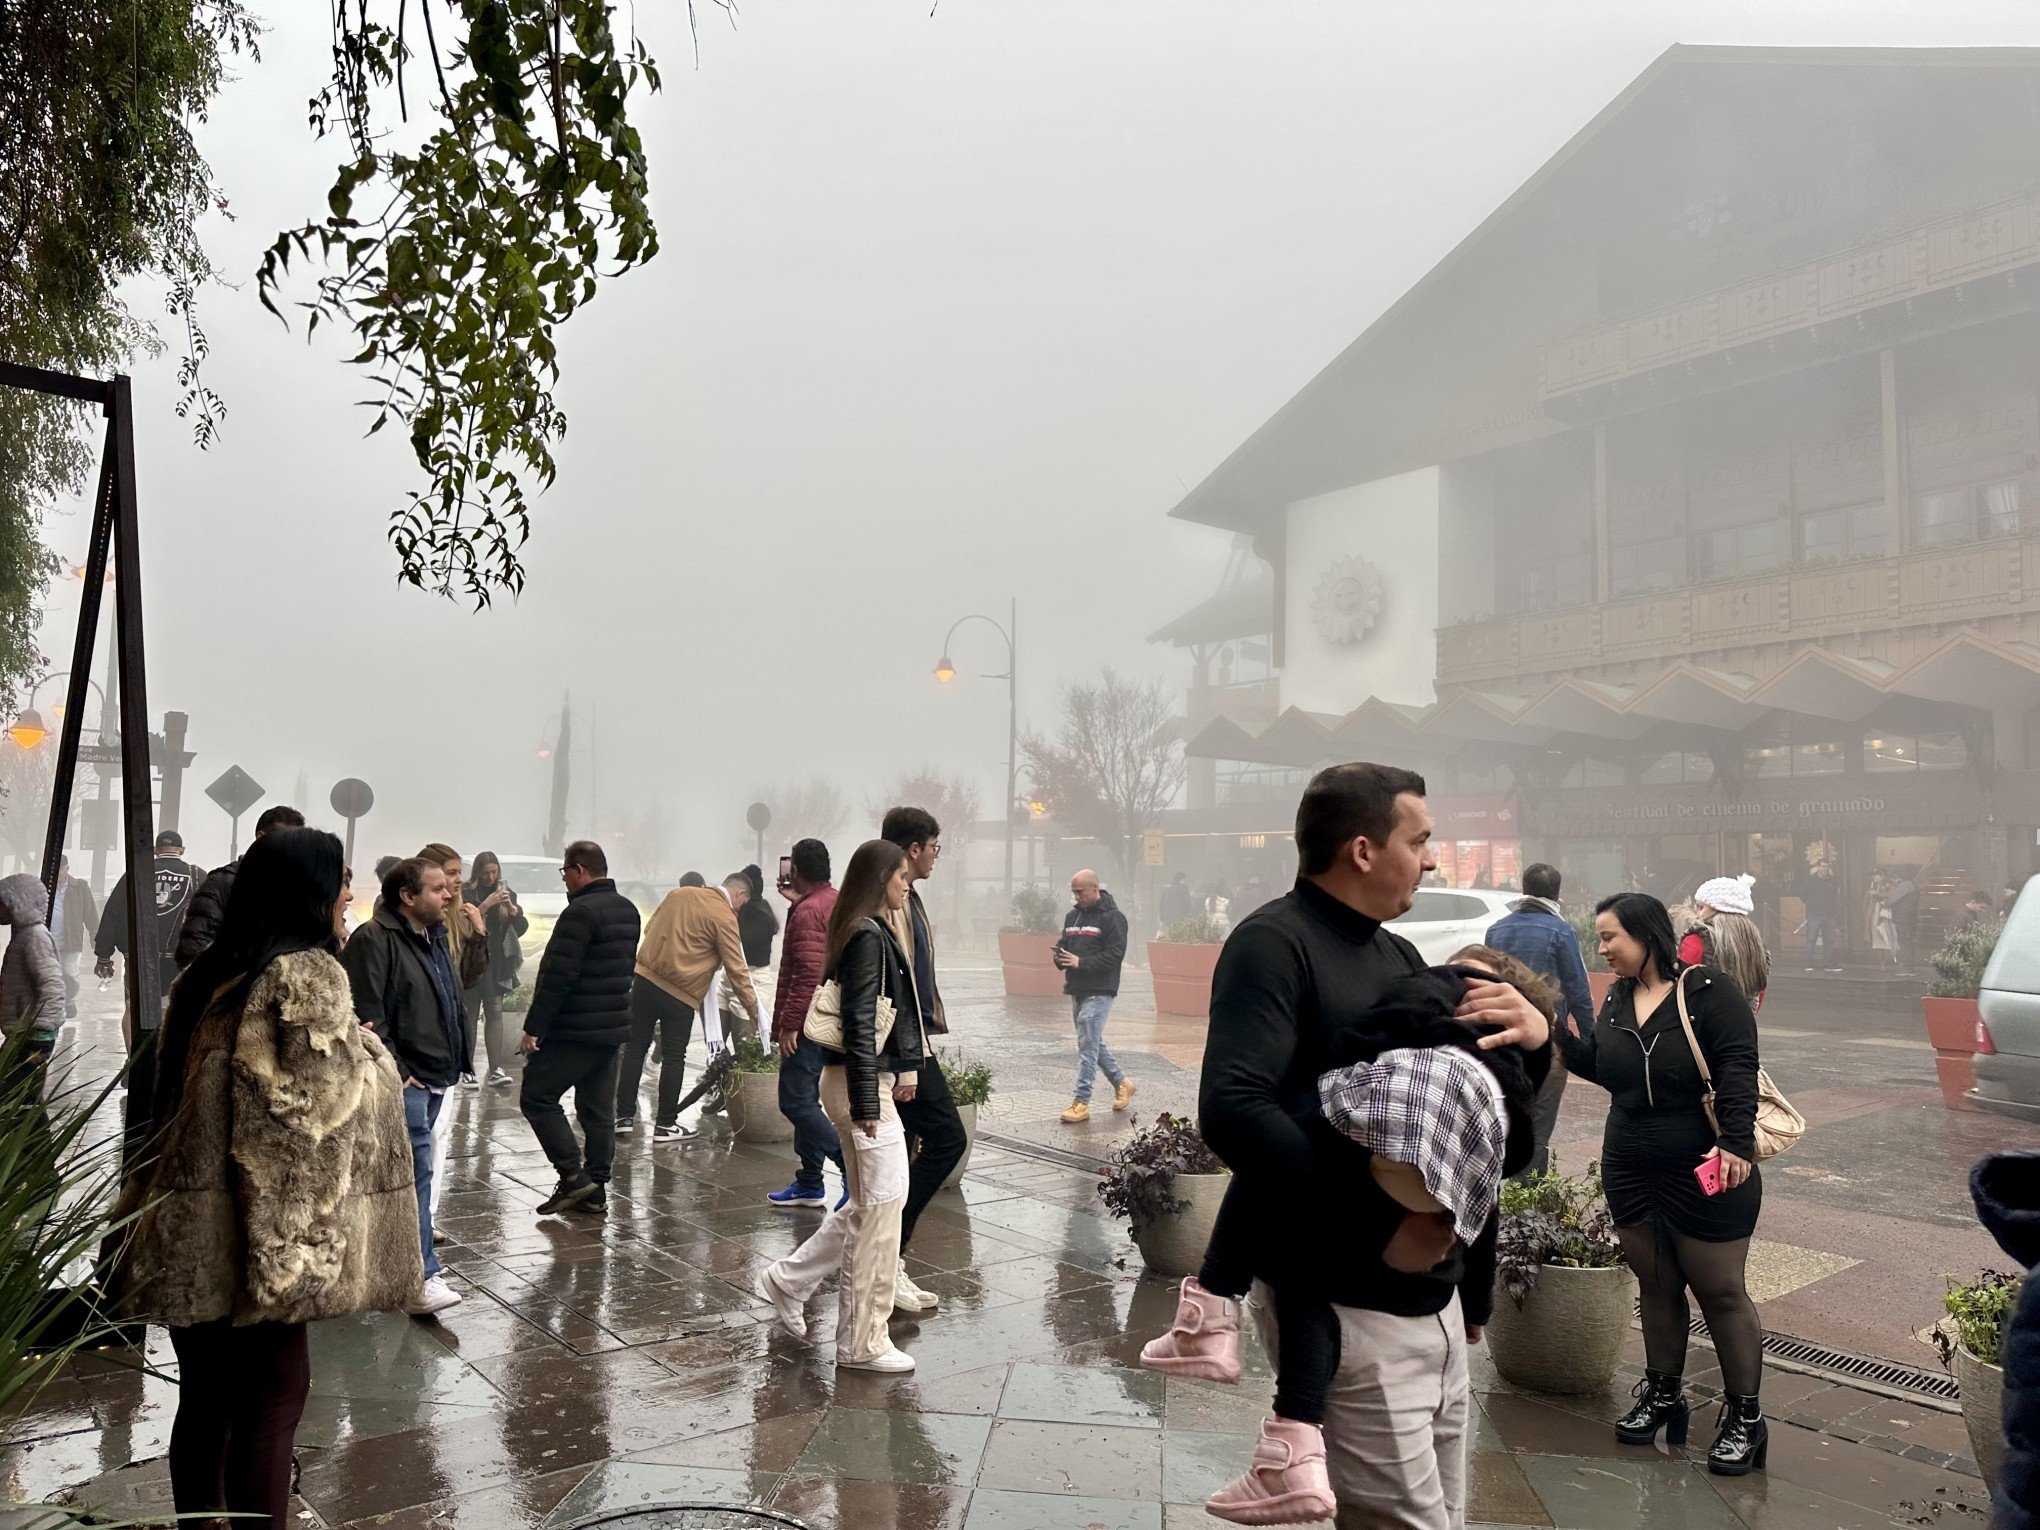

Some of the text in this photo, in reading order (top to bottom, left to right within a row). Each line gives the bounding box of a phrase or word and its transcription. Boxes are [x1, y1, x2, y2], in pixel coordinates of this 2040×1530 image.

[79, 753, 108, 761] Madre
[1677, 803, 1696, 817] de
[1703, 802, 1763, 817] cinema
[1771, 800, 1790, 815] de
[1800, 797, 1886, 819] gramado
[157, 875, 185, 883] IDERS
